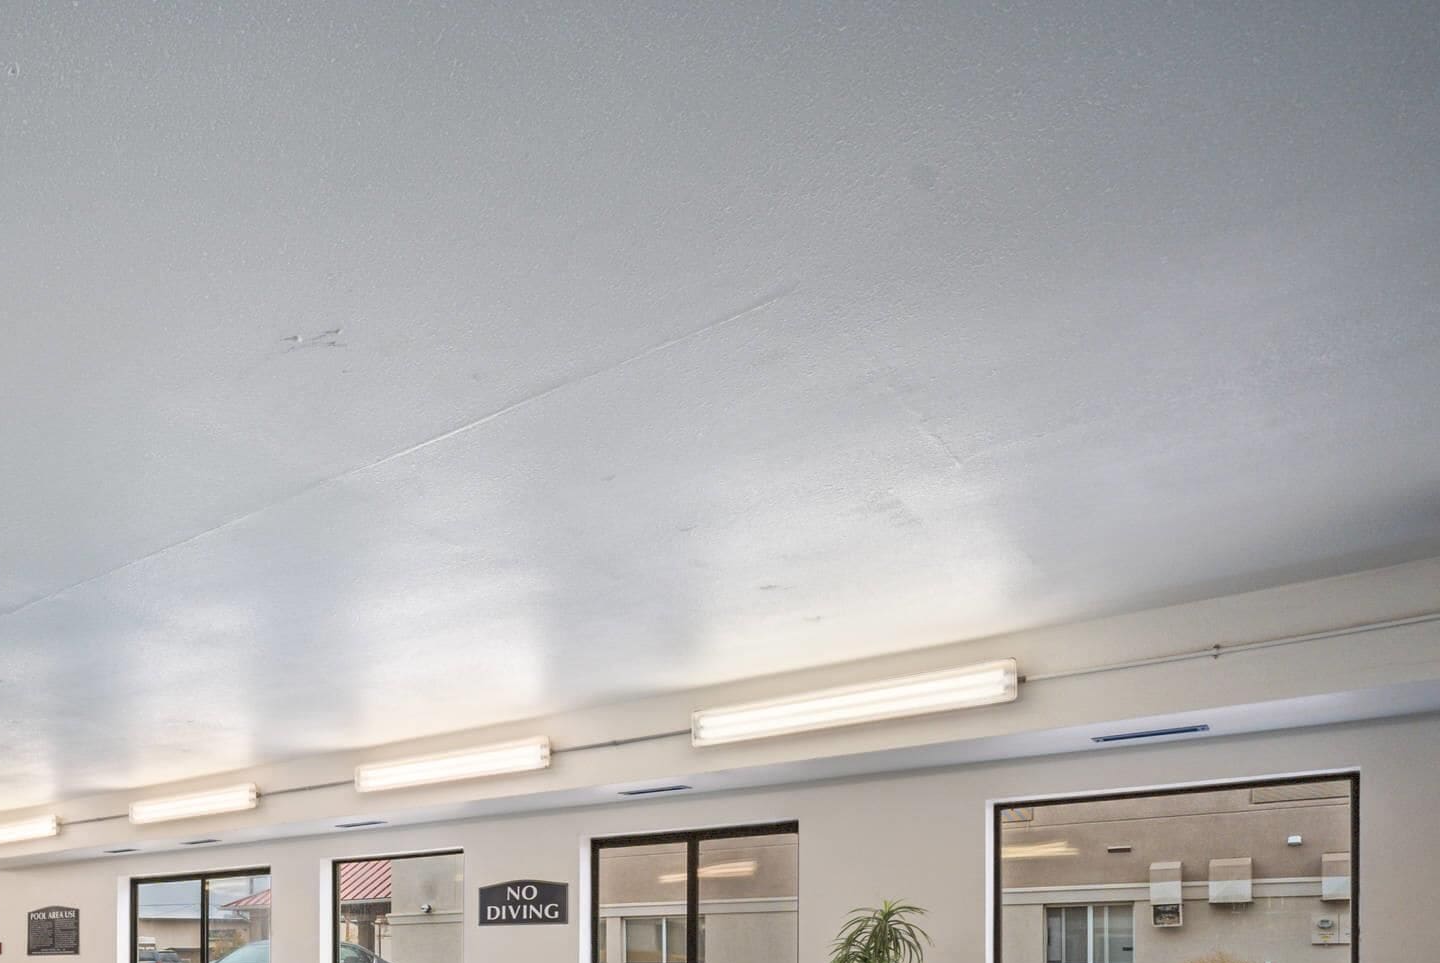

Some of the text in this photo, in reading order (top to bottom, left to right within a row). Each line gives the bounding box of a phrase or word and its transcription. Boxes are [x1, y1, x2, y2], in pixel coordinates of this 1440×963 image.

[506, 884, 538, 901] NO
[30, 910, 76, 920] POOL AREA USE
[486, 903, 560, 920] DIVING
